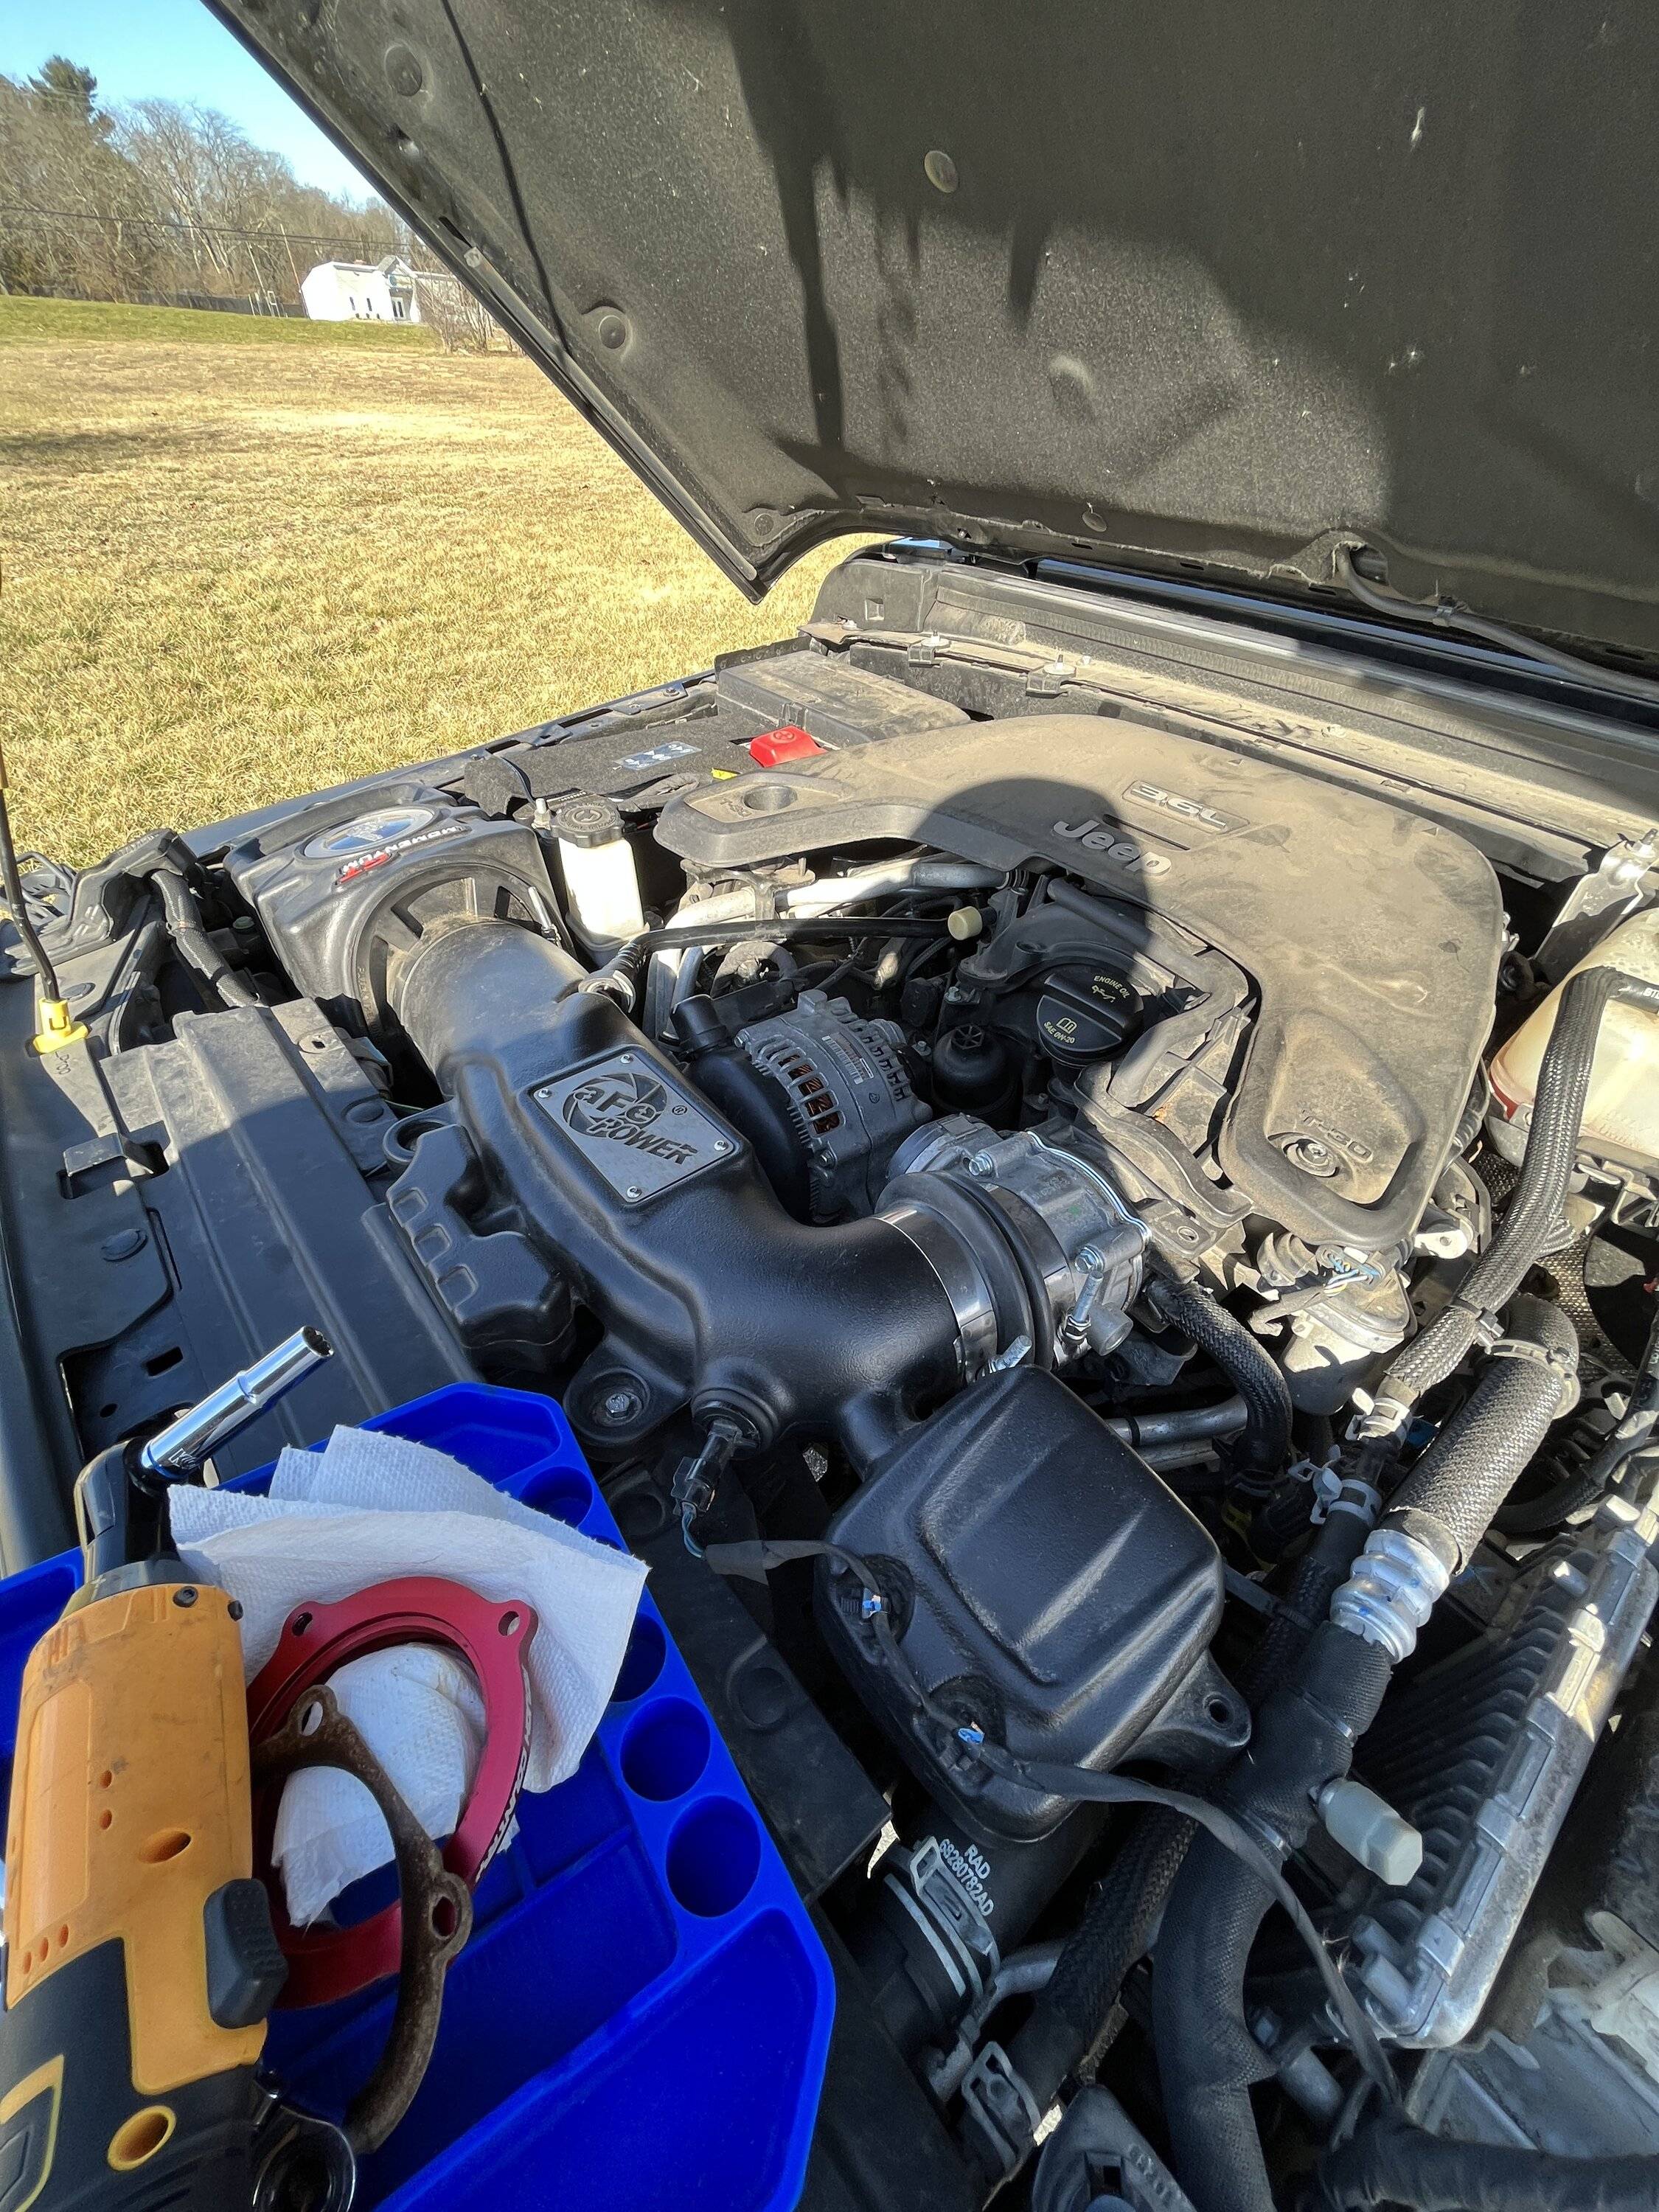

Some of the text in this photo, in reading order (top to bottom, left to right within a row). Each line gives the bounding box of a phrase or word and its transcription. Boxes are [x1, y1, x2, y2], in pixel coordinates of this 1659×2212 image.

[1053, 819, 1172, 876] Jeep
[1093, 975, 1130, 998] ENGINE OIL
[1044, 1021, 1075, 1044] SAE 0W-20
[587, 1116, 698, 1165] POWER
[939, 1838, 994, 1916] 68280782AD
[964, 1844, 990, 1879] RAD
